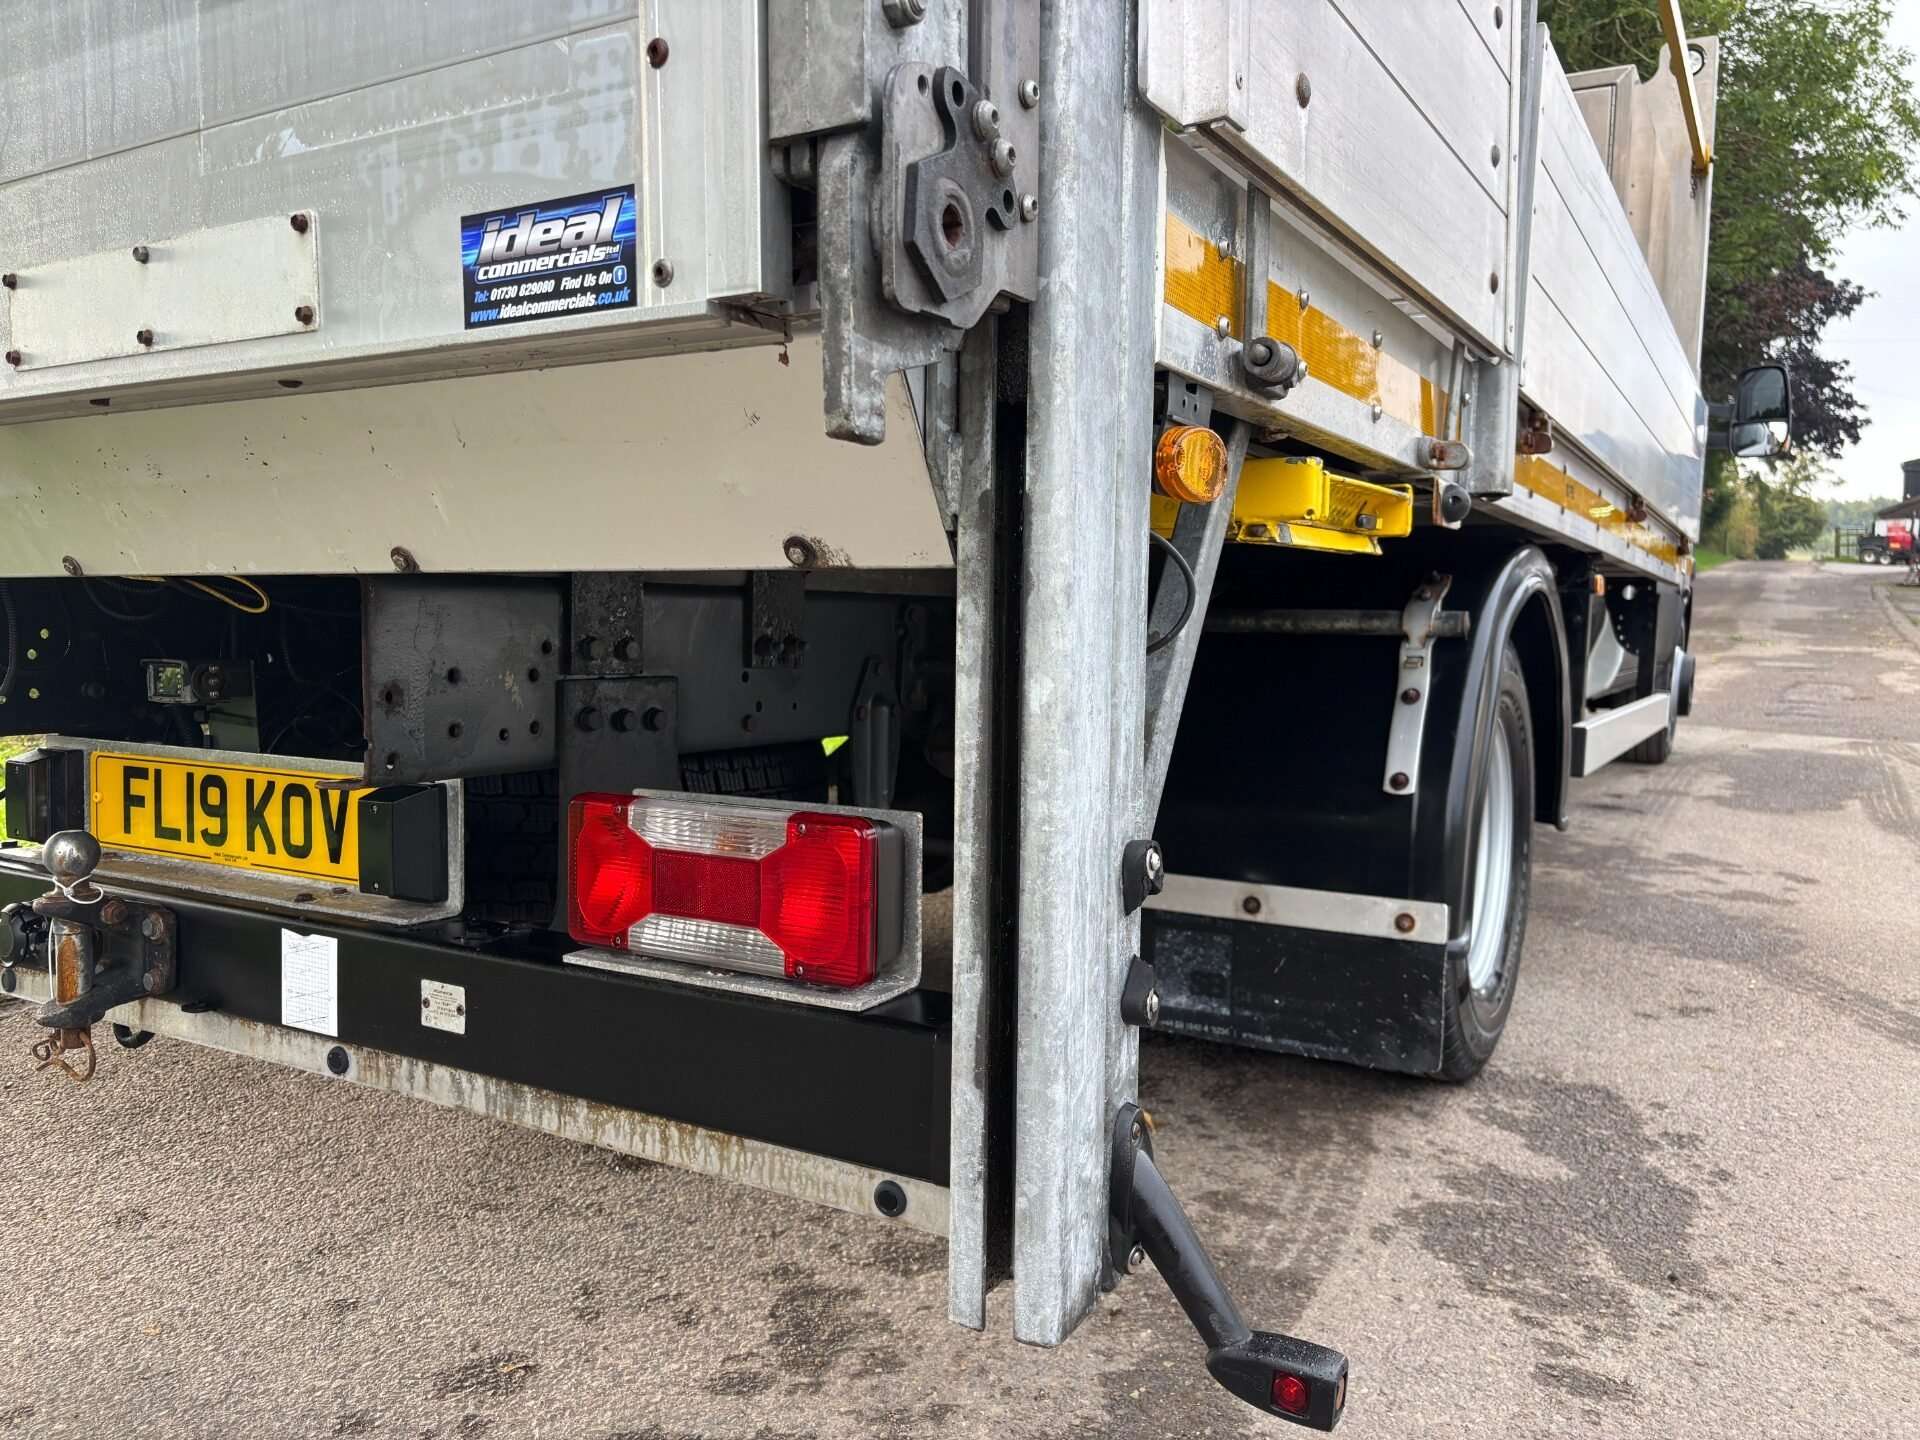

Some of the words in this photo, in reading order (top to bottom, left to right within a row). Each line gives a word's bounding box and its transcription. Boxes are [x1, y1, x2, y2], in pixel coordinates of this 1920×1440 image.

[476, 197, 625, 265] ideal
[477, 244, 606, 281] commercials
[470, 287, 631, 323] www.idealcommercials.co.uk
[474, 290, 489, 303] Tel:
[490, 285, 518, 301] 01730
[519, 279, 555, 297] 829080
[560, 274, 583, 291] Find
[583, 273, 597, 287] Us
[598, 271, 613, 285] On
[123, 765, 229, 847] FL19
[245, 778, 350, 865] KOV
